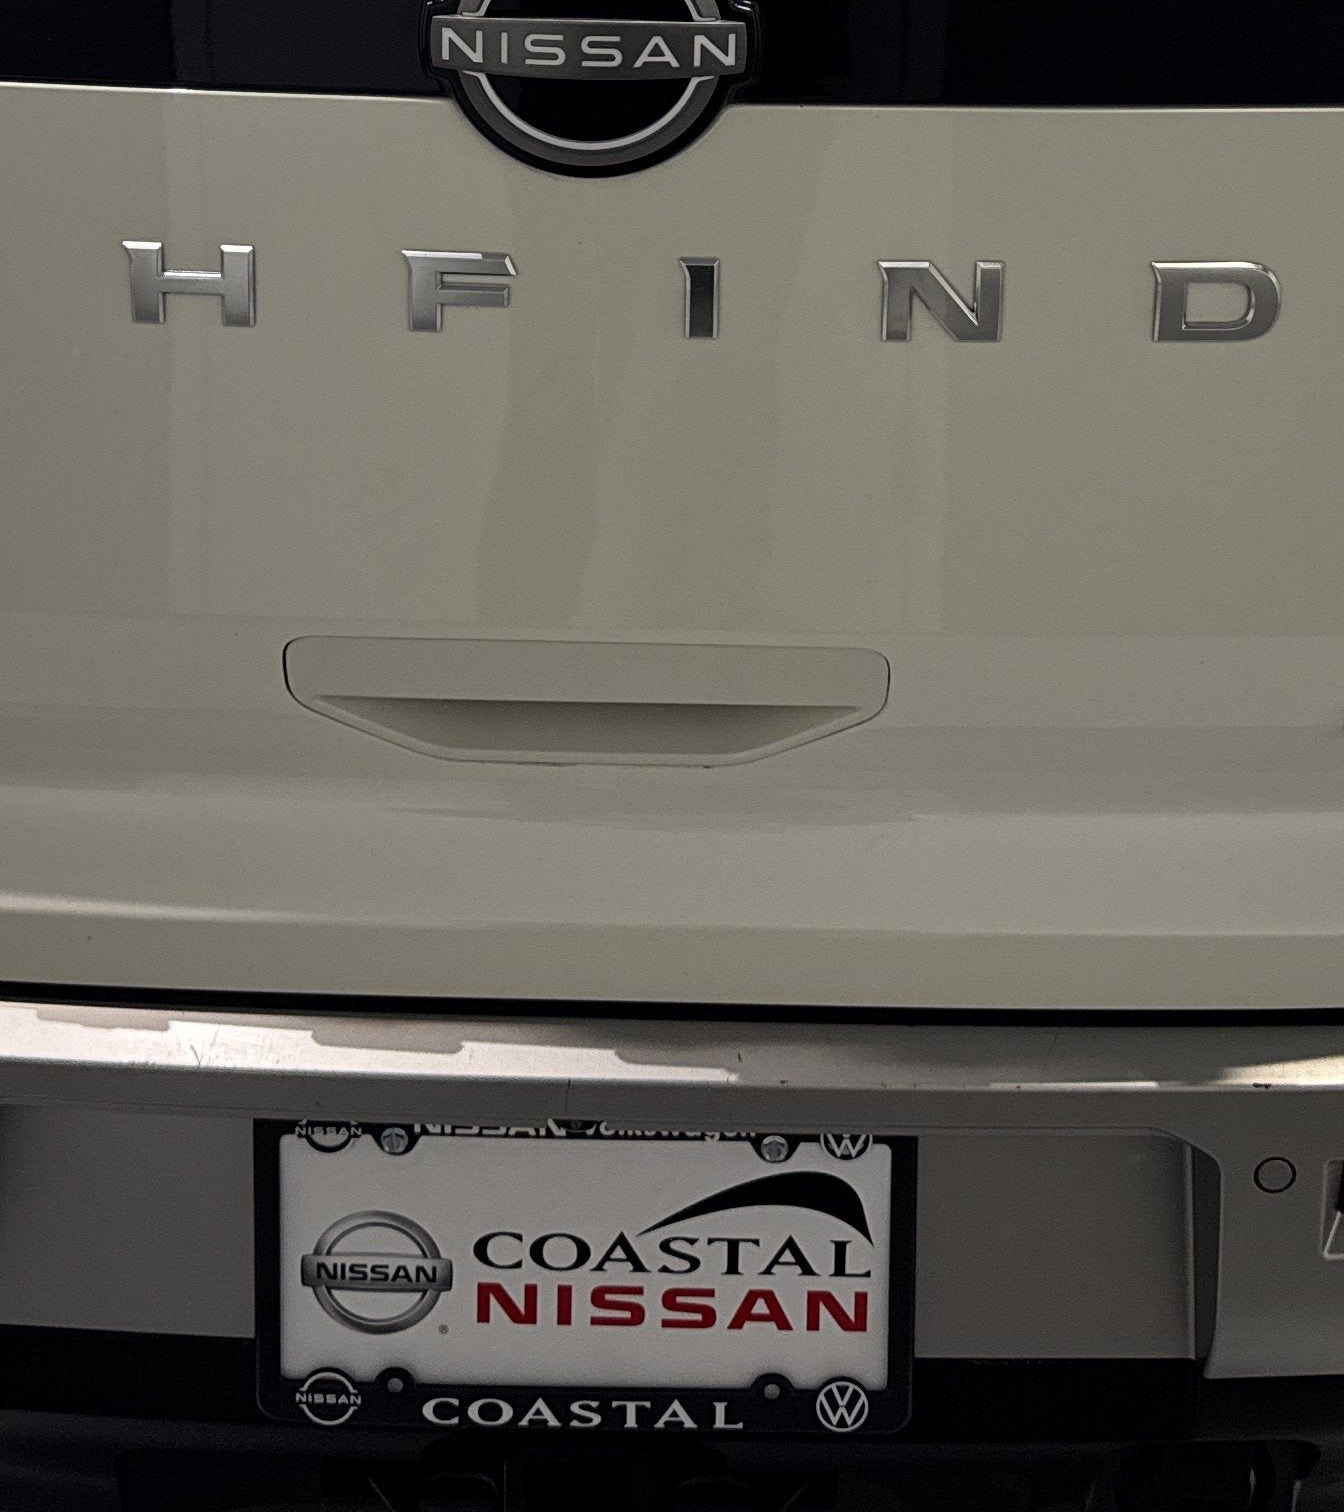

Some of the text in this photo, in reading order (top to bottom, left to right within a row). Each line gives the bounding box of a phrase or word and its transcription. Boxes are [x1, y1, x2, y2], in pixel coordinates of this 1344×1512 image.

[441, 27, 737, 68] NISSAN
[294, 1125, 362, 1137] NISSAN
[472, 1231, 872, 1278] COASTAL
[316, 1260, 438, 1284] NISSAN
[476, 1282, 868, 1332] NISSAN
[295, 1392, 362, 1405] NISSAN
[421, 1397, 744, 1430] COASTAL
